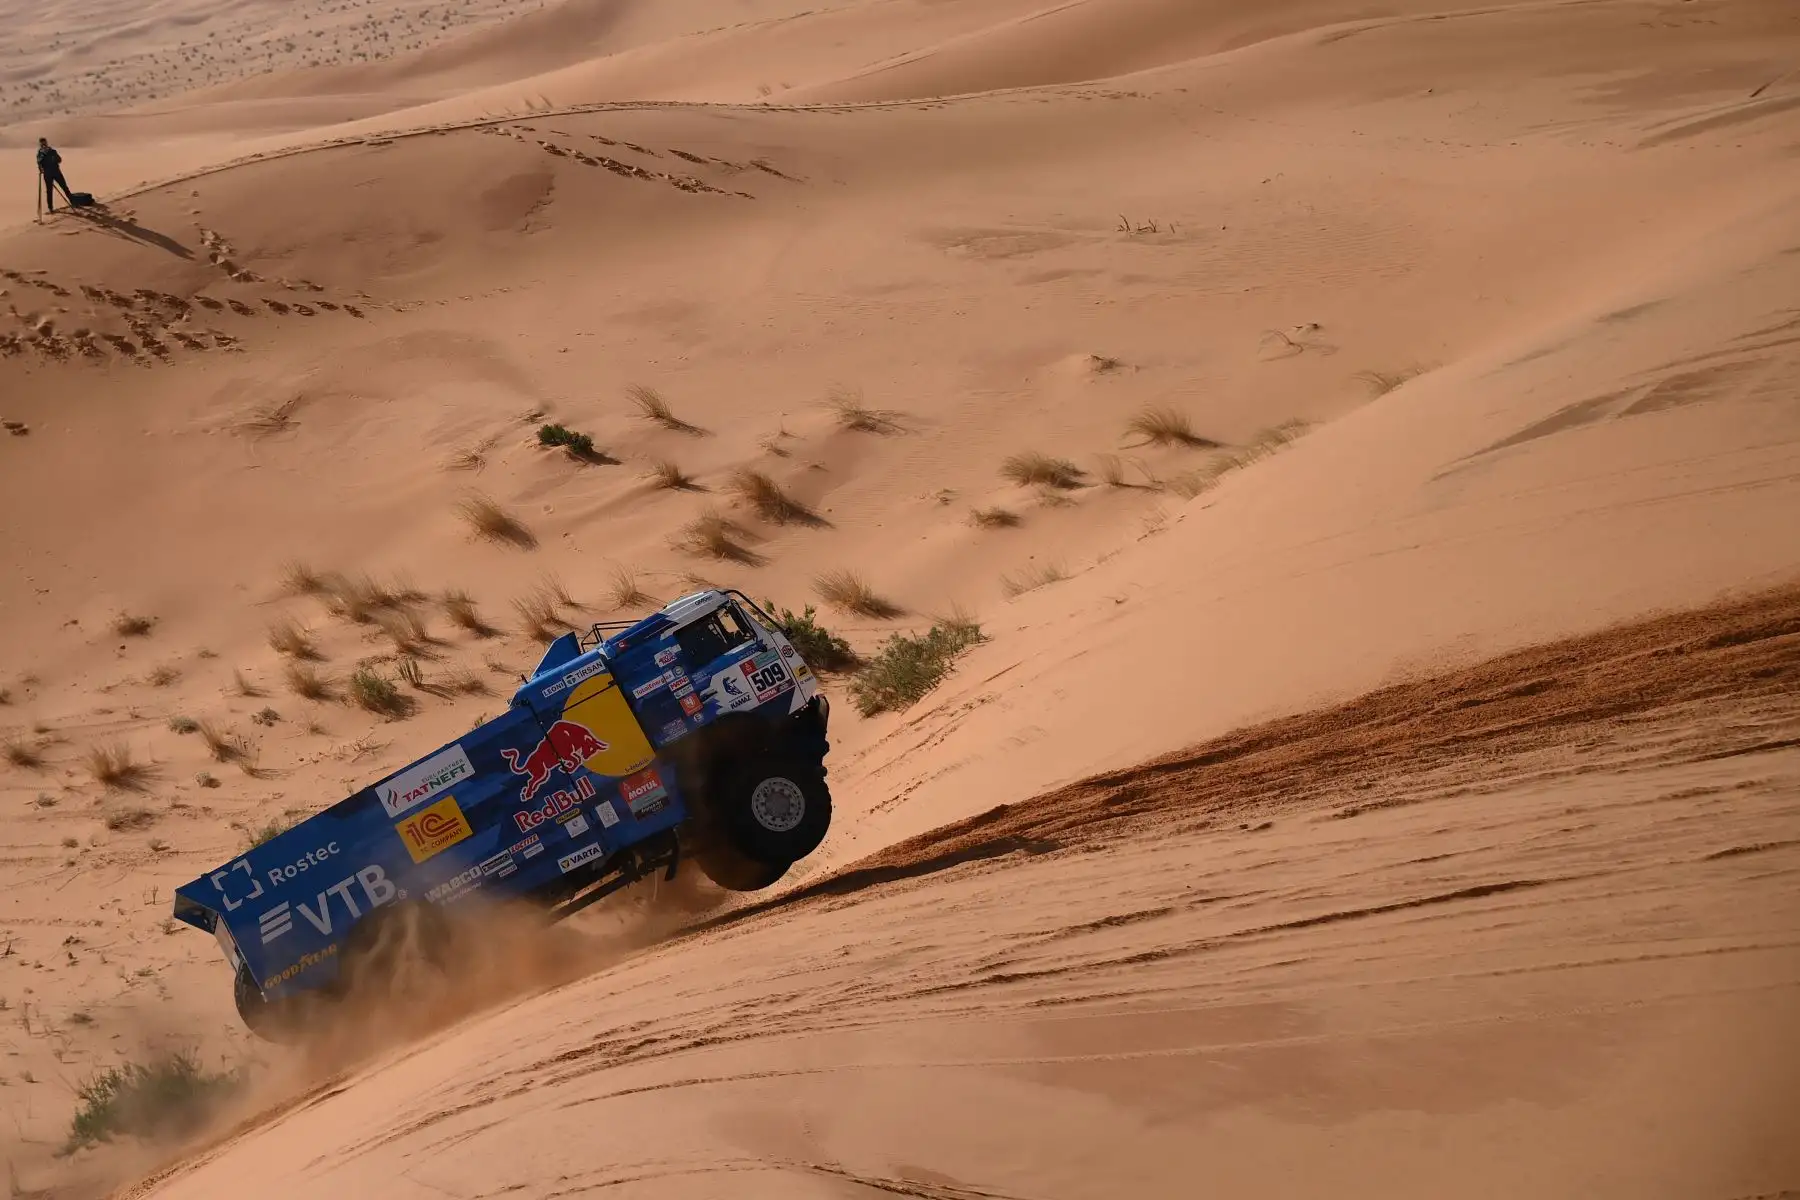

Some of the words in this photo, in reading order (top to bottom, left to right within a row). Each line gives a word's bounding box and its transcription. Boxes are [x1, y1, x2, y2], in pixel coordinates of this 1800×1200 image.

[543, 682, 565, 697] LEONI
[750, 662, 786, 692] 509
[730, 693, 752, 709] KAMAZ
[437, 758, 464, 774] PARTNER
[402, 763, 466, 803] TATNEFT
[628, 780, 658, 800] MOTUL
[406, 813, 460, 847] 1C
[431, 827, 464, 849] COMPANY
[268, 841, 340, 887] Rostec
[570, 846, 600, 864] VARTA
[295, 864, 396, 936] VTB
[424, 866, 481, 904] WABCO
[264, 943, 338, 990] GOODYEAR
